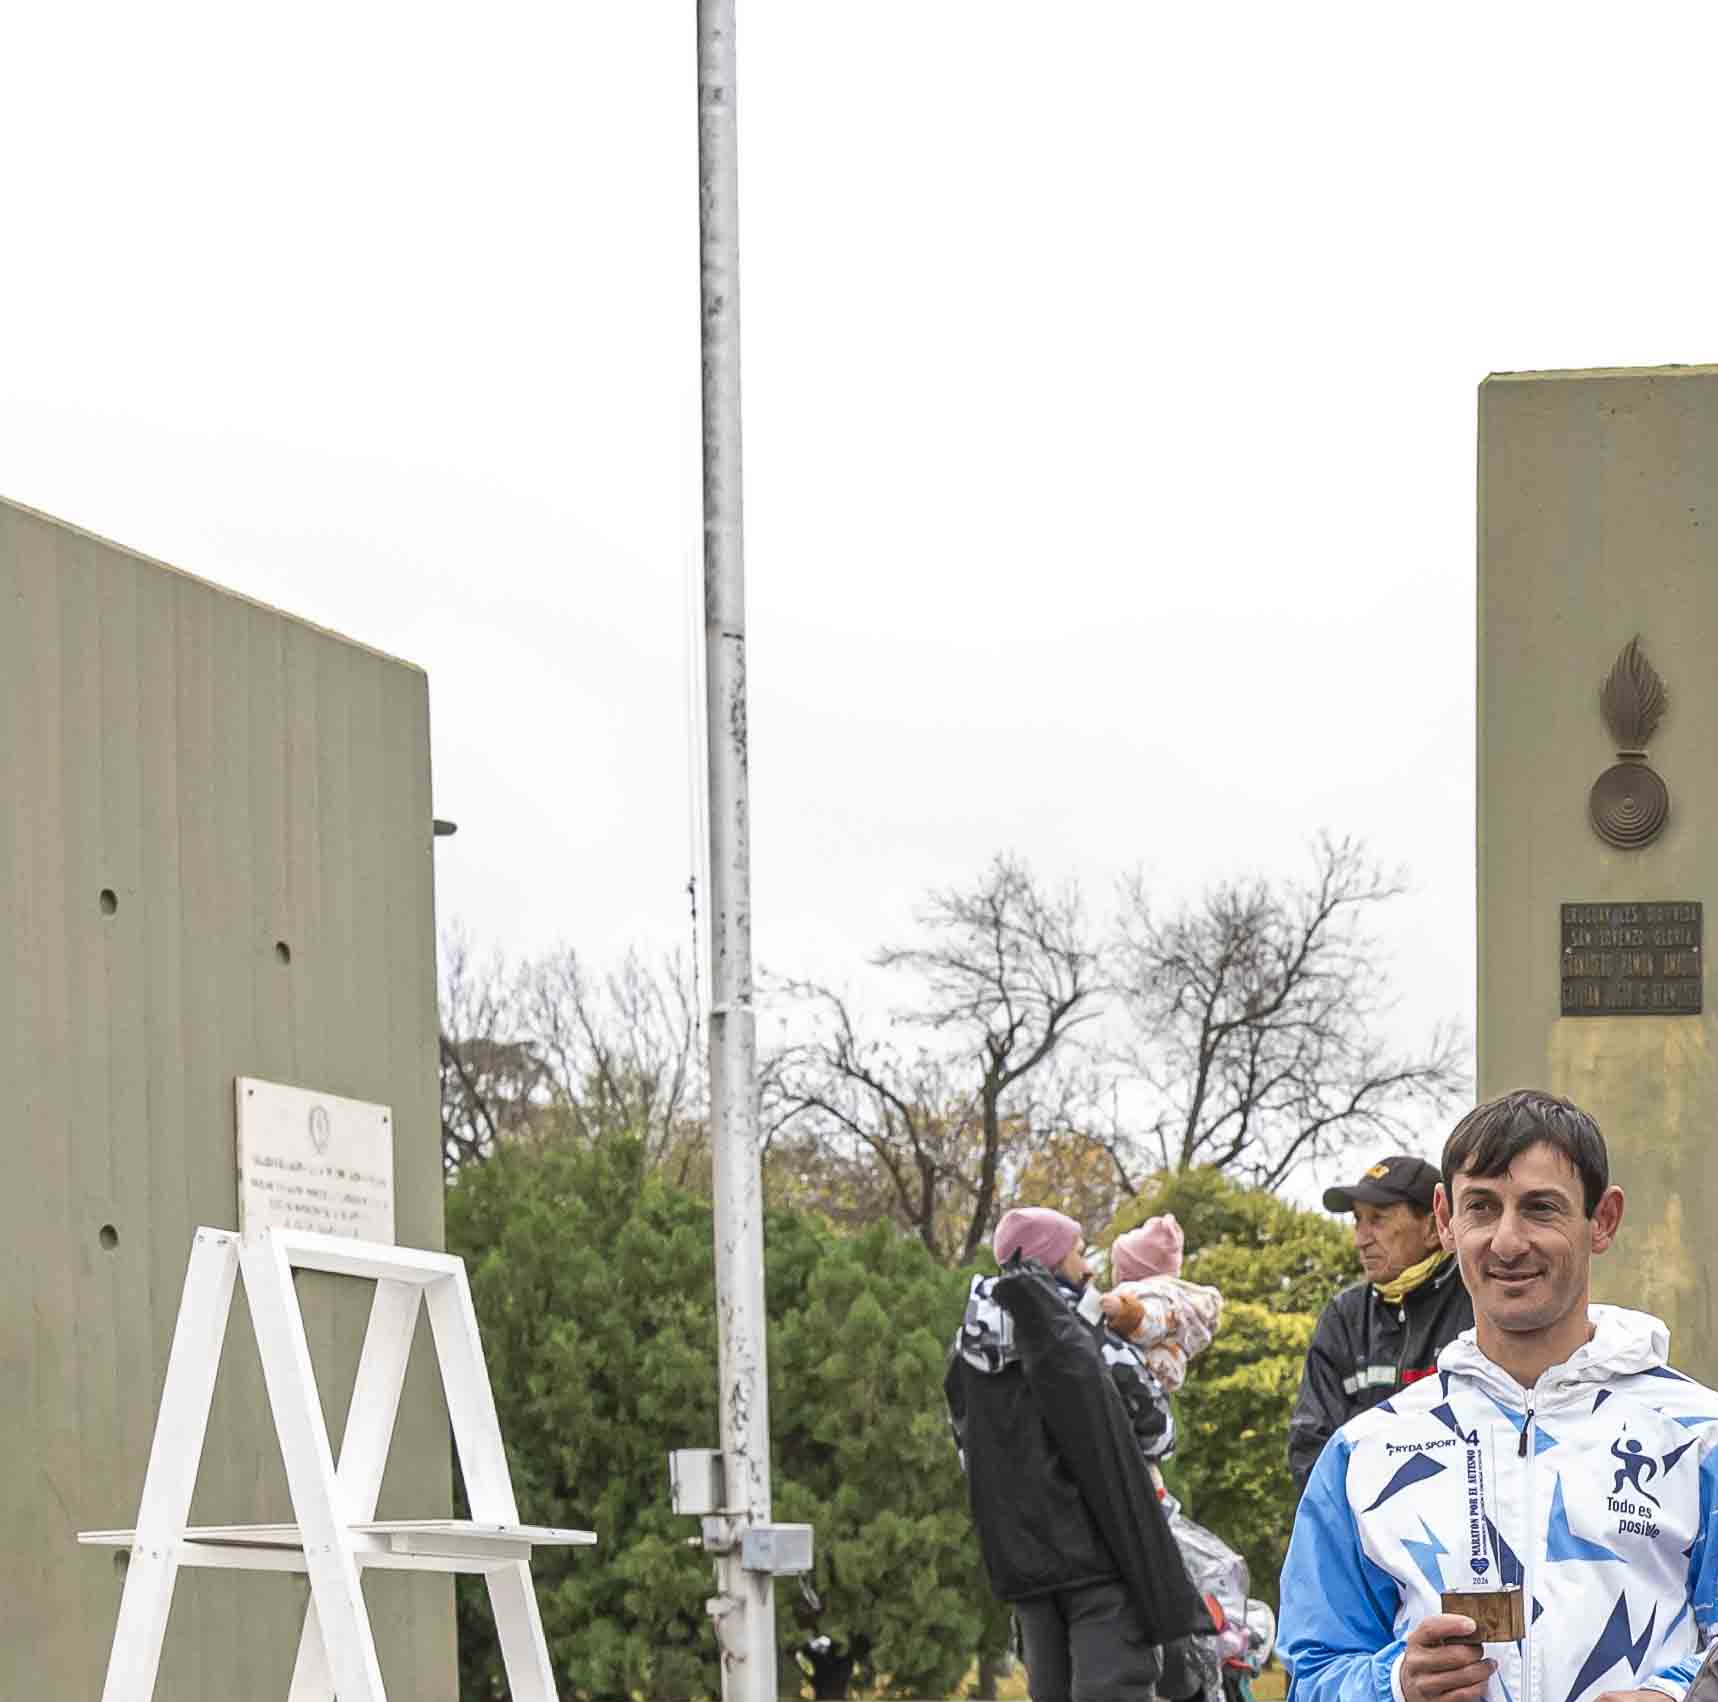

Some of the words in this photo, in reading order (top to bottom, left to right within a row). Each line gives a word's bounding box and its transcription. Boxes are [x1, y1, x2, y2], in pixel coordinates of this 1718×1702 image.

[1425, 1439, 1456, 1450] SPORT
[1465, 1429, 1479, 1446] 4
[1466, 1450, 1476, 1484] AUTISMO
[1468, 1487, 1478, 1495] EL
[1469, 1498, 1479, 1516] POR
[1607, 1496, 1635, 1514] Todo
[1638, 1505, 1652, 1519] es
